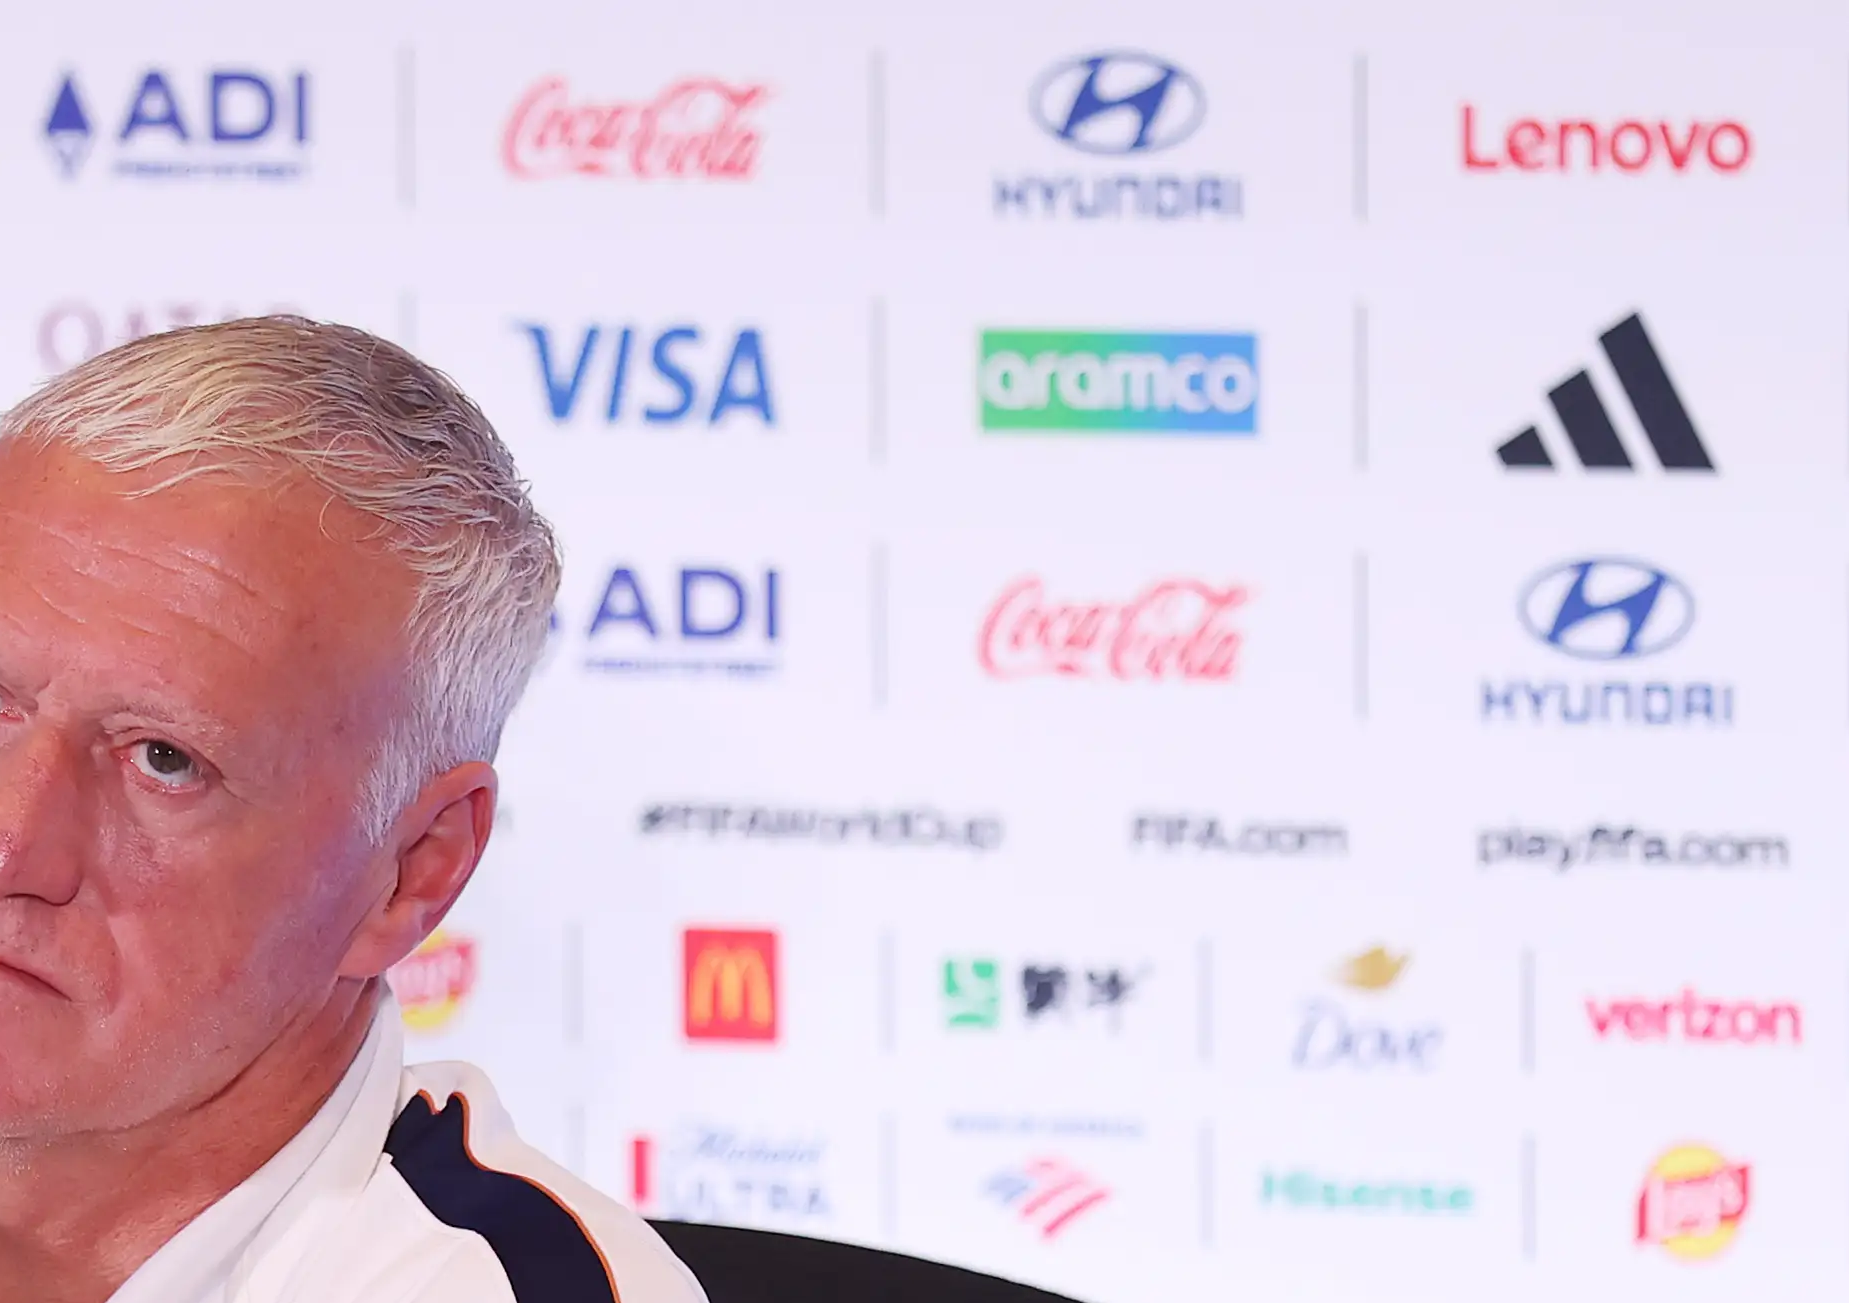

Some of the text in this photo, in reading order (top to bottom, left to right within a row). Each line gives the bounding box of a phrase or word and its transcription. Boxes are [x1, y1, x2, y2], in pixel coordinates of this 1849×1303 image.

[118, 70, 309, 145] ADI
[1461, 105, 1752, 173] Lenovo
[993, 174, 1242, 219] HYUNDAI
[523, 325, 776, 425] VISA
[985, 351, 1255, 412] aramco
[587, 566, 778, 641] ADI
[1481, 681, 1733, 725] HYUNDAI
[1131, 812, 1348, 855] FIFA.com
[1292, 1000, 1442, 1068] Dove
[1585, 990, 1801, 1043] verizon
